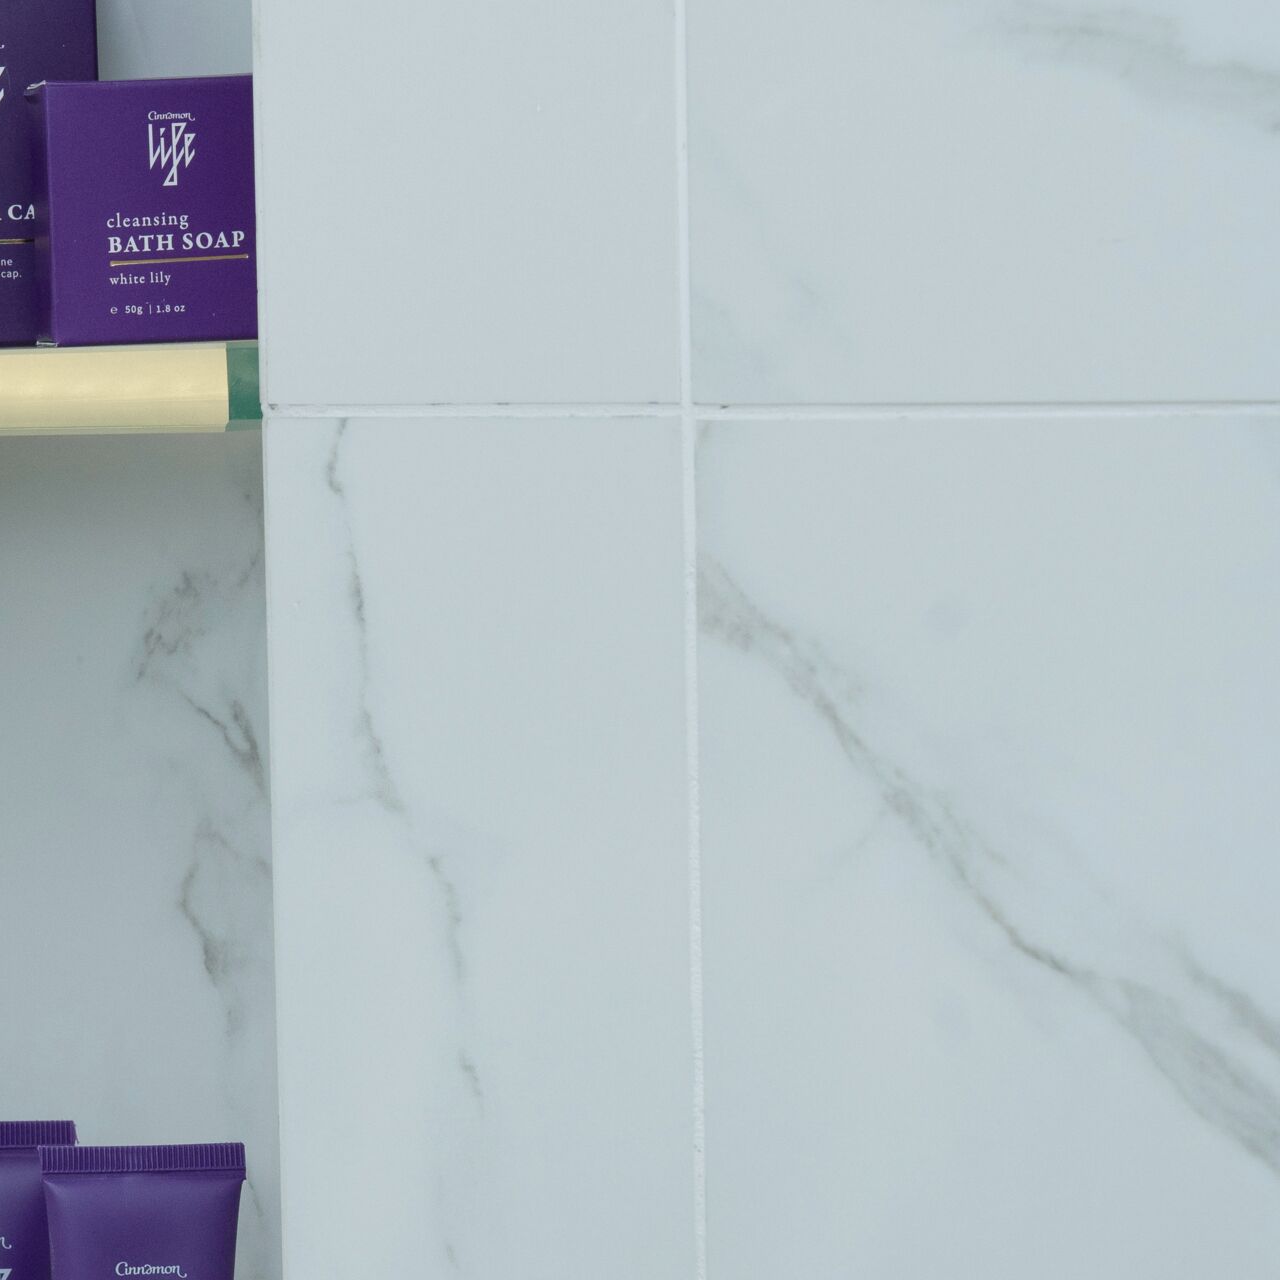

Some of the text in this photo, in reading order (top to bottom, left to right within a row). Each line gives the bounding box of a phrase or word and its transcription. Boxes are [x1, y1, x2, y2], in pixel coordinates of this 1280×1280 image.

[147, 110, 196, 122] Cinnamon
[106, 211, 189, 230] cleansing
[107, 230, 246, 254] BATH SOAP
[1, 270, 22, 281] cap.
[109, 271, 171, 287] white lily
[124, 304, 144, 316] 50g
[156, 304, 171, 314] 1.8
[174, 304, 186, 313] oz
[115, 1261, 188, 1279] Cinnamon
